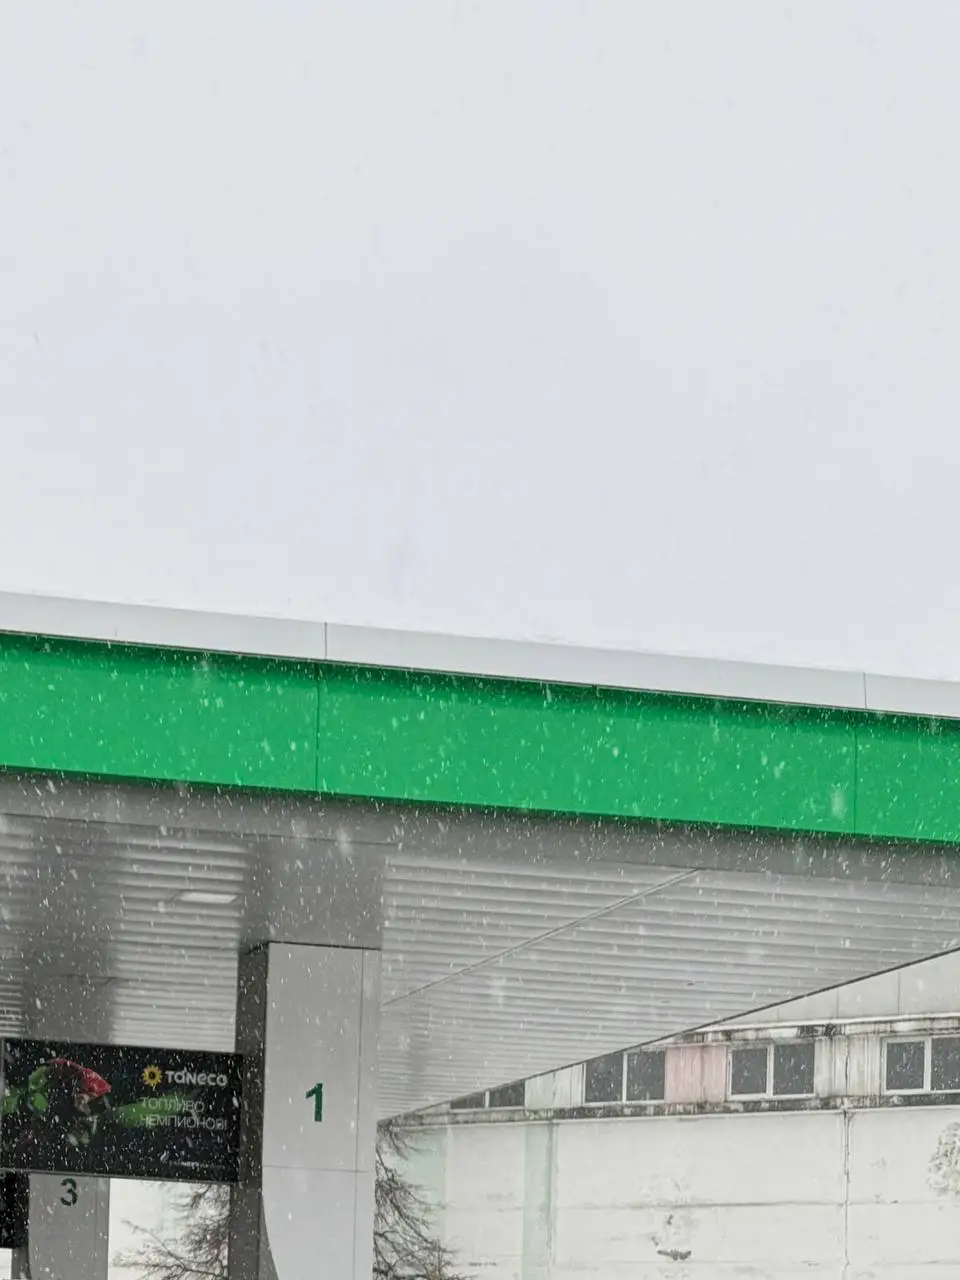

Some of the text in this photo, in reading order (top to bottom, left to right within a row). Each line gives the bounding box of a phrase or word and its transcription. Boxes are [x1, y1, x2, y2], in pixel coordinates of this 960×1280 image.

[141, 1096, 205, 1113] ТОПЛИВО
[305, 1082, 323, 1122] 1
[60, 1178, 78, 1206] 3
